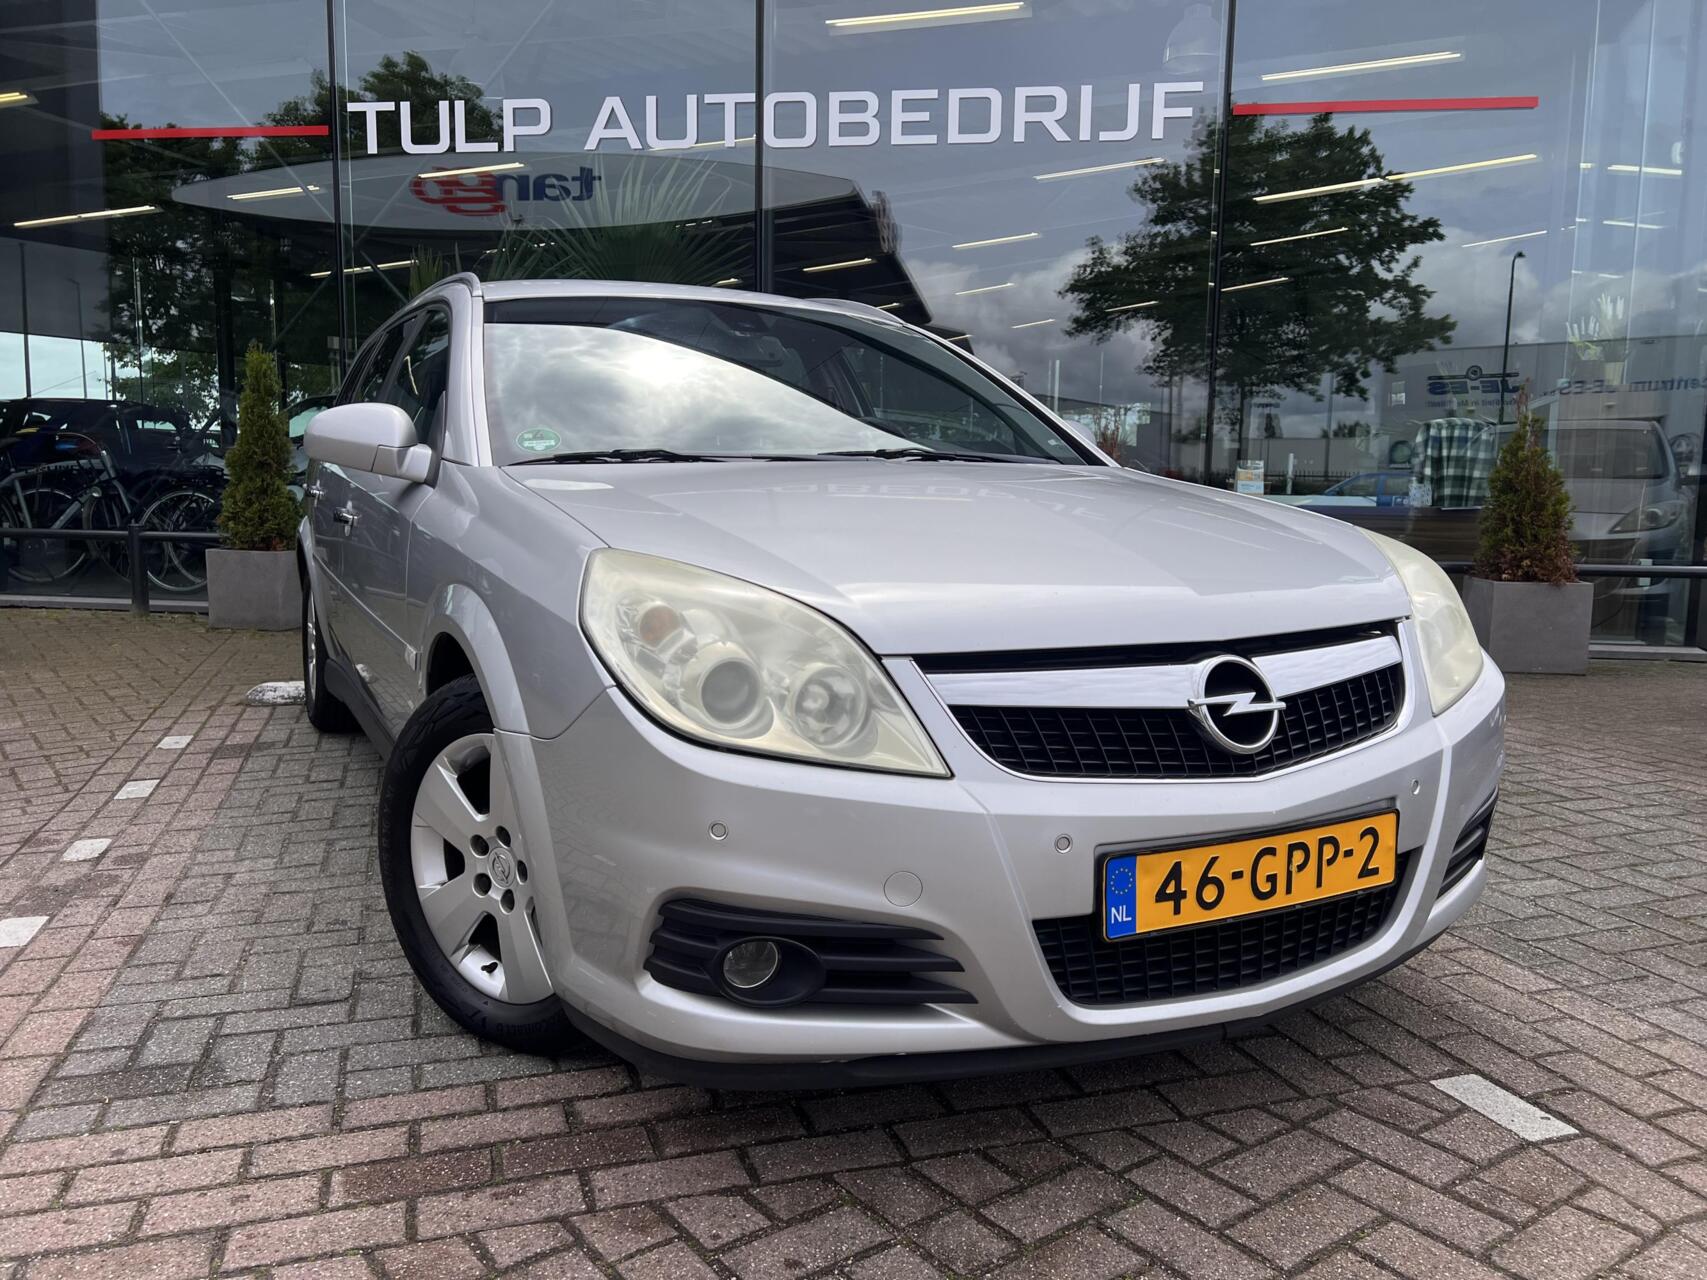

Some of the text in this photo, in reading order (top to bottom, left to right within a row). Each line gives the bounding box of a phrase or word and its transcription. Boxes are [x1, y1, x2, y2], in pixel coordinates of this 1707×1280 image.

[346, 81, 1205, 155] TULP AUTOBEDRIJF
[1154, 826, 1381, 916] 46-GPP-2
[1110, 905, 1132, 925] NL
